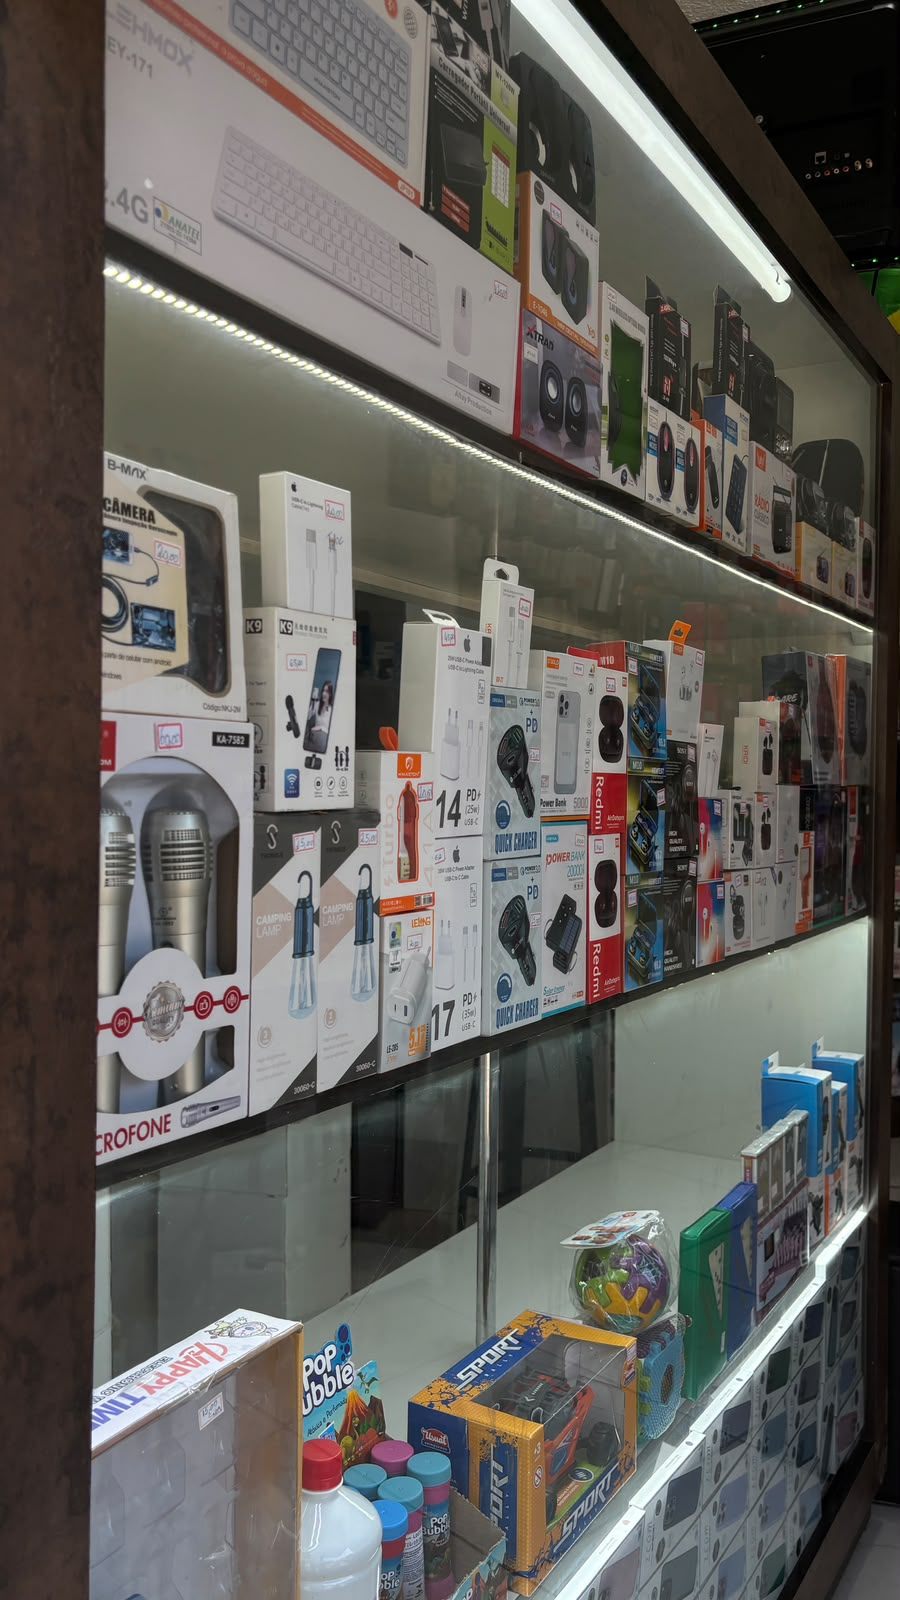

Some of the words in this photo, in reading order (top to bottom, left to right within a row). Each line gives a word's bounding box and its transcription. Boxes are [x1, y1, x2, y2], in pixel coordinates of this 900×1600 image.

[107, 36, 152, 79] EY-171
[107, 459, 148, 481] B-MAX
[103, 497, 156, 525] CÂMERA
[247, 620, 262, 632] K9
[280, 620, 293, 634] K9
[216, 734, 246, 746] KA-7582
[466, 788, 477, 802] PD
[540, 798, 555, 807] Power
[555, 797, 567, 807] Bank
[596, 776, 604, 830] Redmi
[435, 789, 461, 829] 14
[495, 832, 513, 853] QUICK
[513, 831, 538, 850] CHARGER
[256, 912, 292, 926] CAMPING
[322, 902, 354, 914] CAMPING
[256, 924, 281, 938] LAMP
[322, 914, 345, 928] LAMP
[593, 943, 602, 998] Redmi
[462, 992, 473, 1007] PD
[432, 1000, 455, 1041] 17
[495, 1004, 514, 1029] QUICK
[514, 998, 539, 1023] CHARGER
[95, 1113, 171, 1156] CROFONE
[455, 1328, 522, 1391] SPORT
[303, 1361, 354, 1416] ubble
[553, 1461, 621, 1553] SPORT
[422, 1522, 450, 1536] Bubbl
